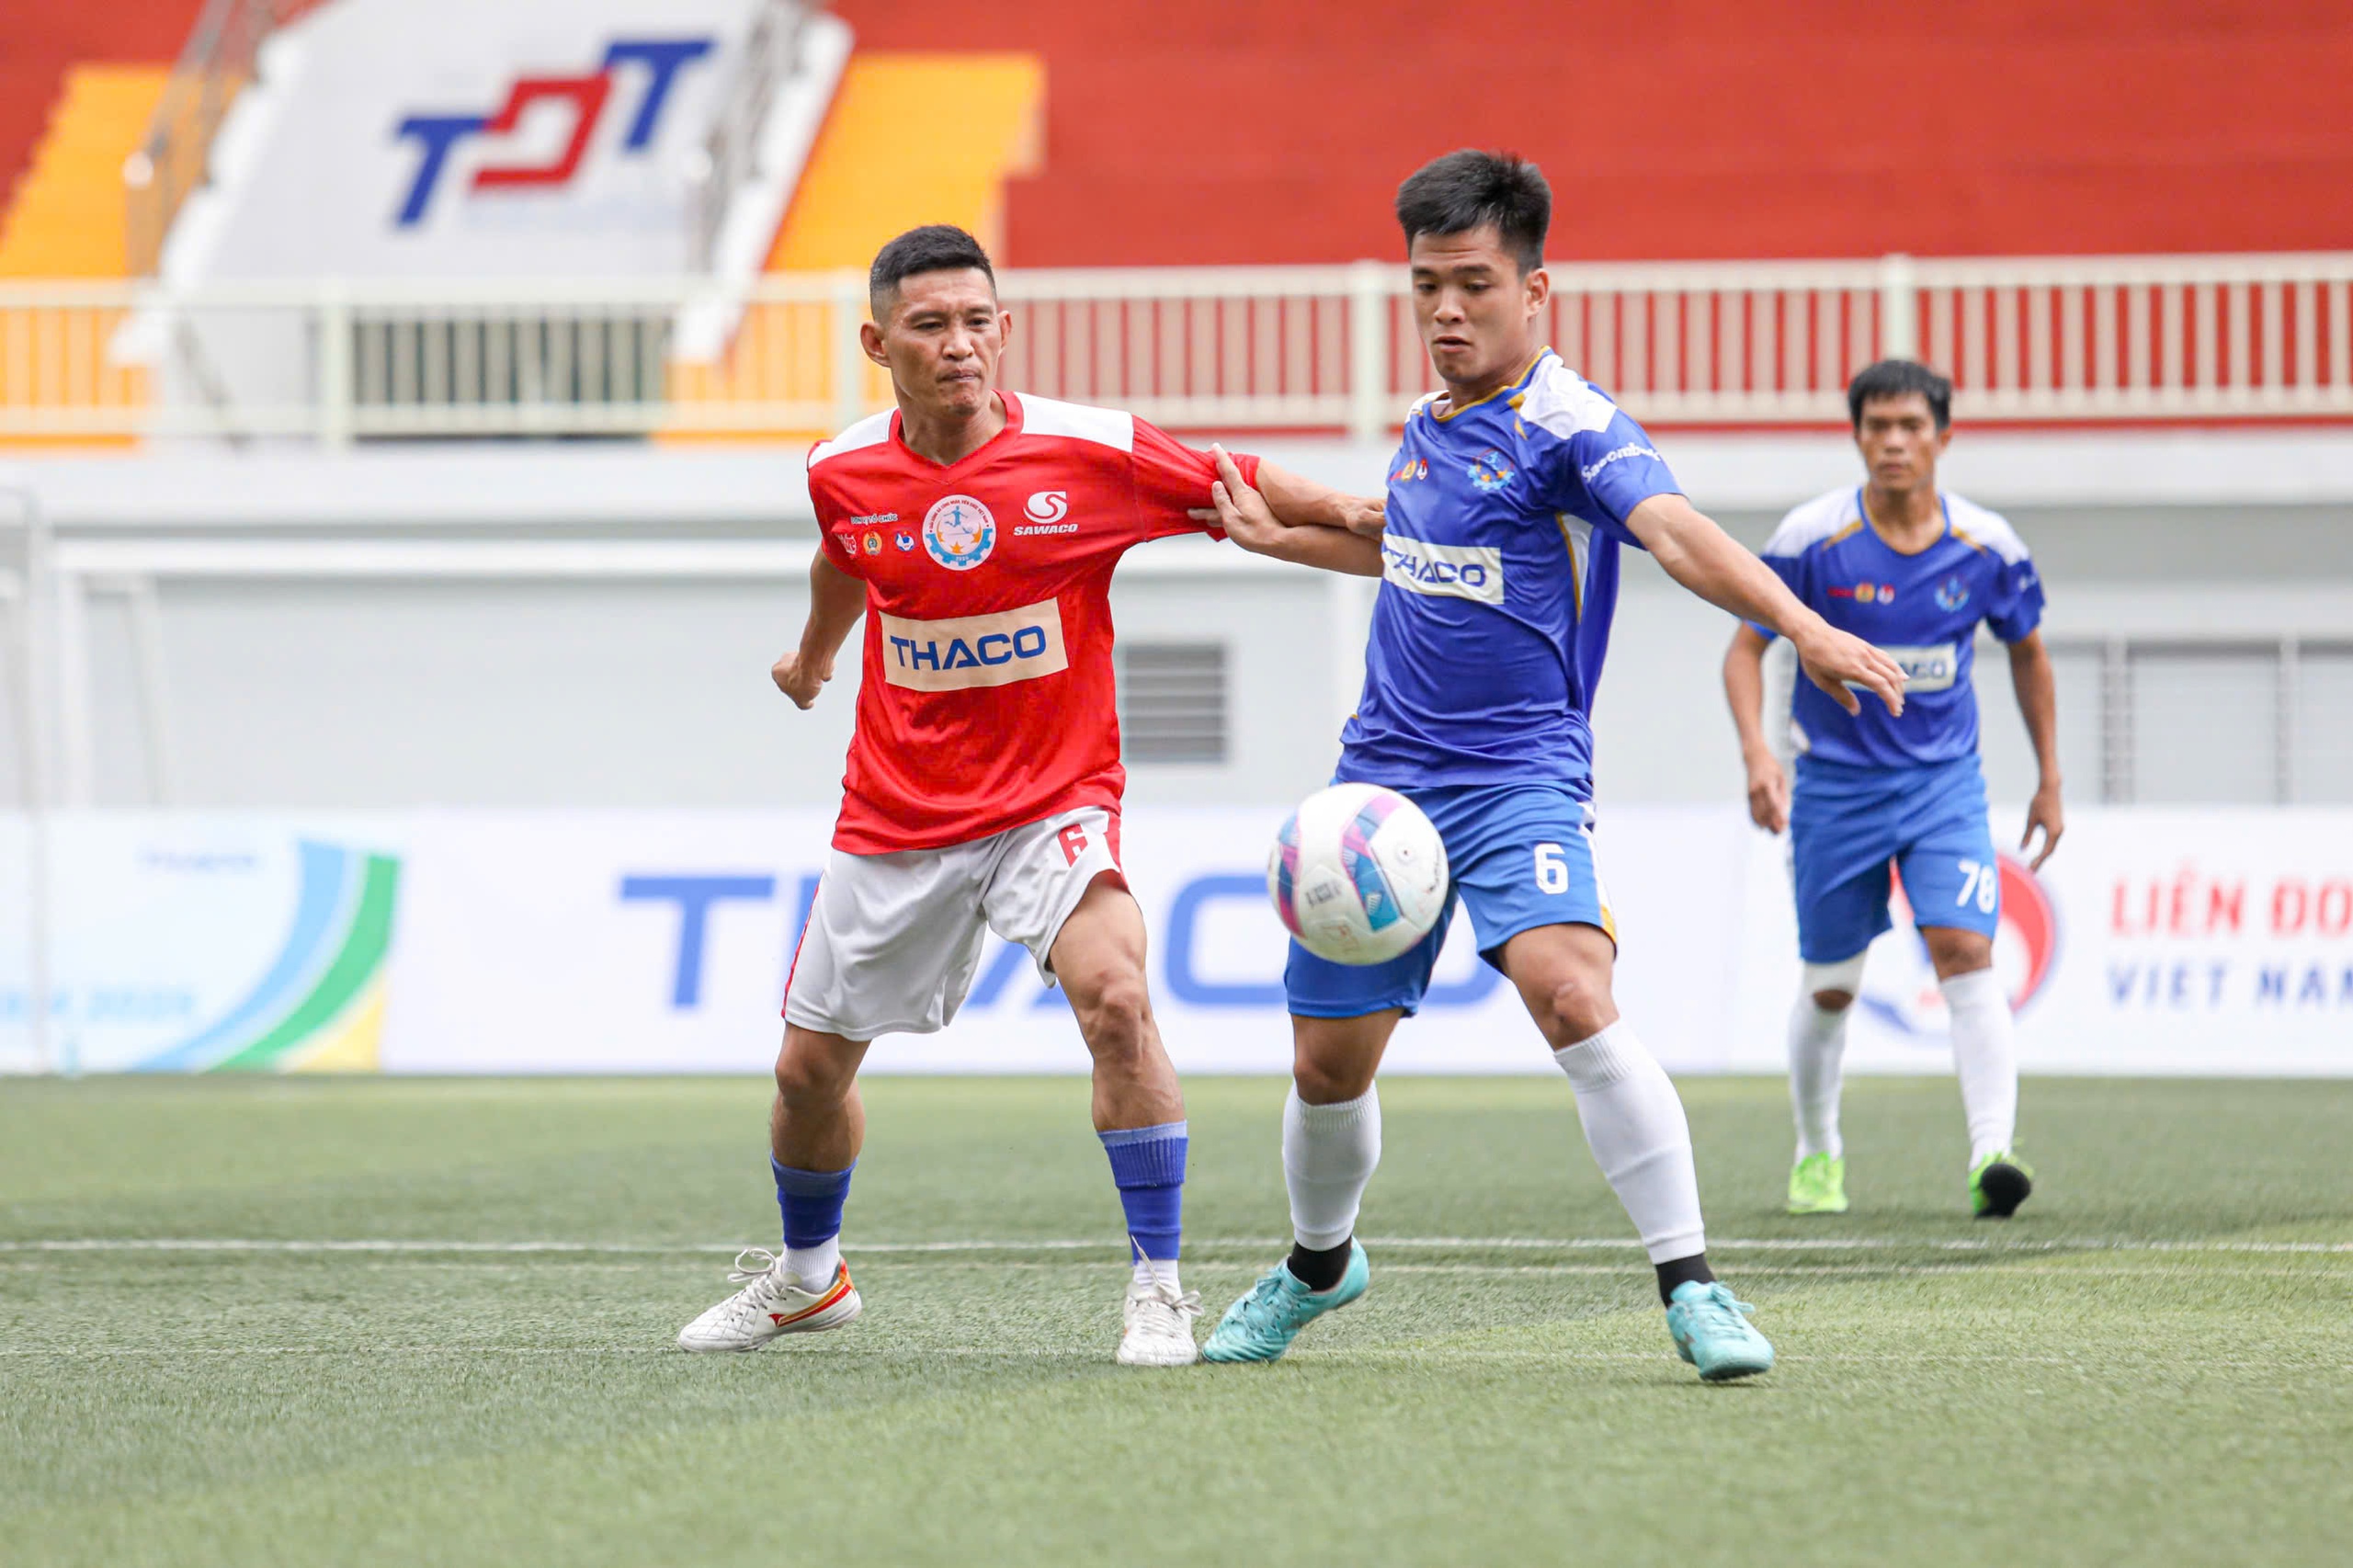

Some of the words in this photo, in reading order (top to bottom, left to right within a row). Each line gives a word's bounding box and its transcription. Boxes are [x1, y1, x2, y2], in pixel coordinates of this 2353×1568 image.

[1014, 523, 1079, 536] SAWACO
[1381, 547, 1486, 587] THACO
[890, 625, 1047, 671] THACO
[1534, 843, 1569, 895] 6
